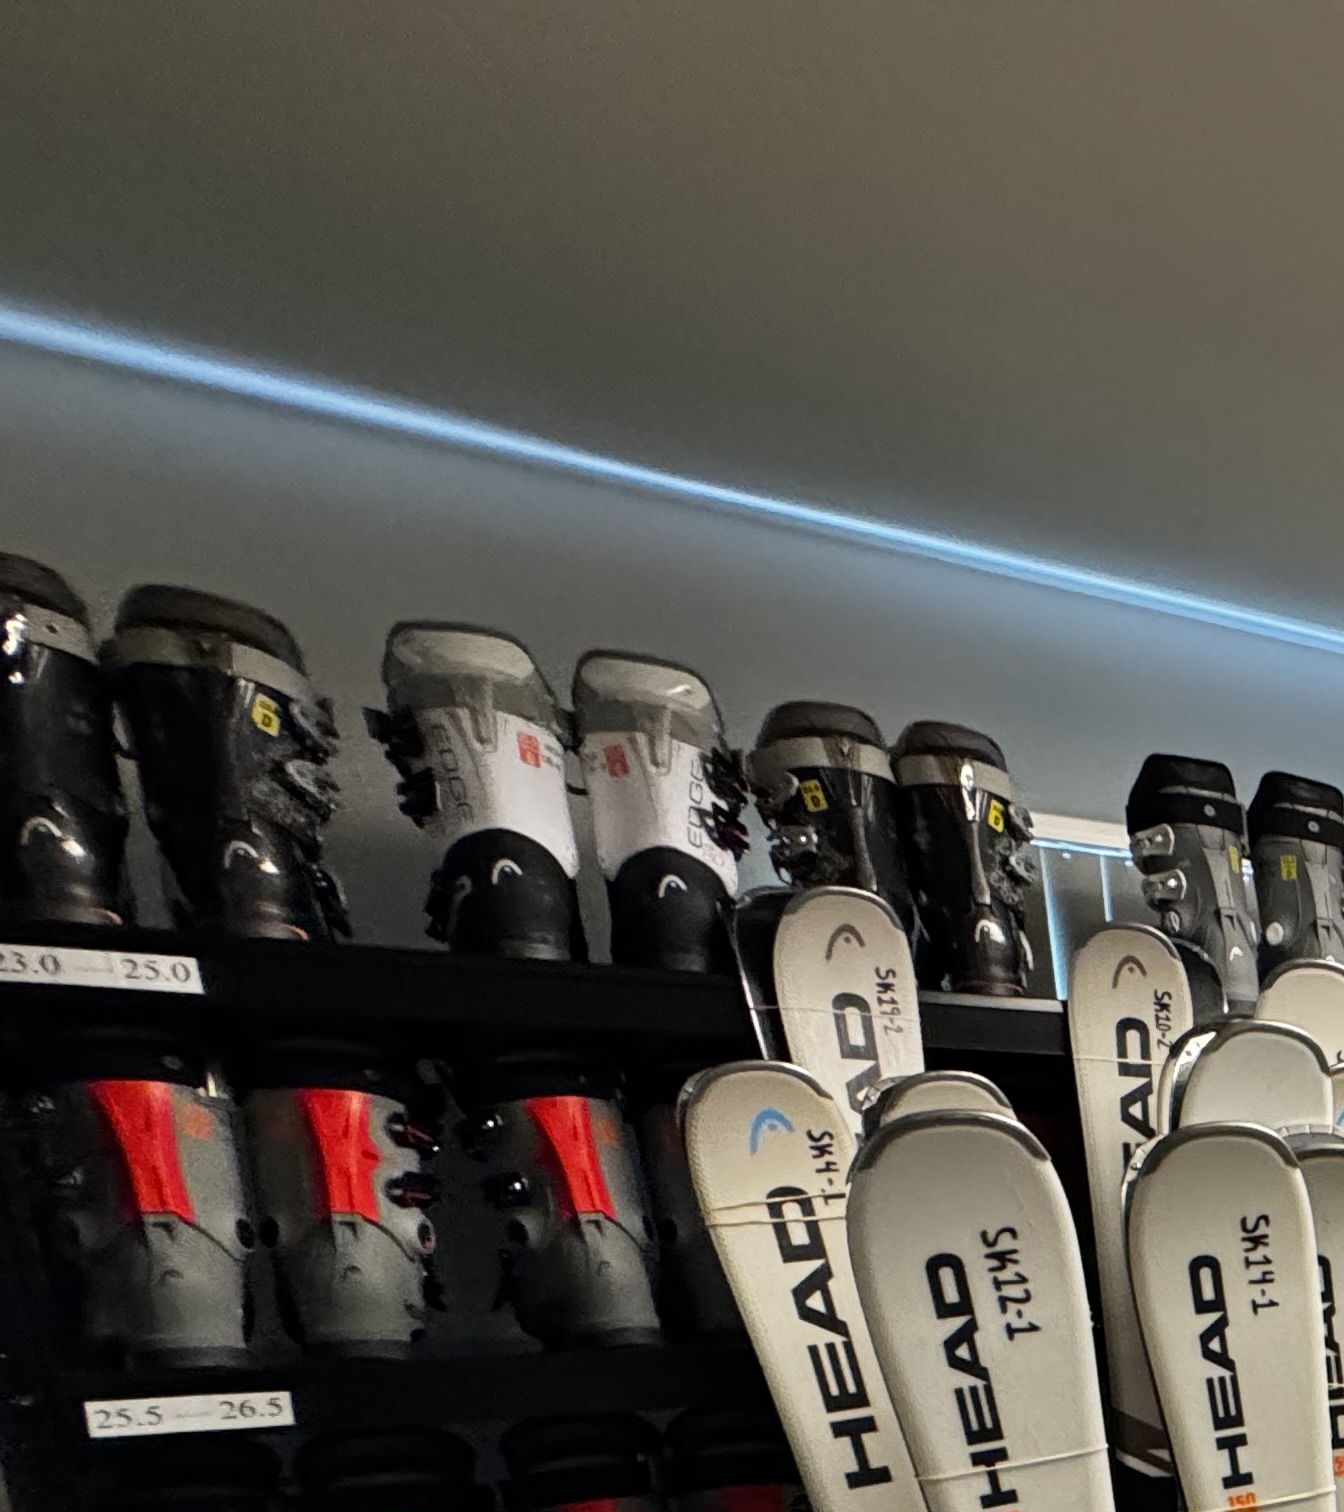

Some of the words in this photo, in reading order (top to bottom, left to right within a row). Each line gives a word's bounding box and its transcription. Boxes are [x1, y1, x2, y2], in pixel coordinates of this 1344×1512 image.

[0, 950, 61, 976] 3.0
[121, 957, 192, 983] 25.0
[831, 991, 882, 1116] AD
[1115, 1016, 1157, 1166] AD
[979, 1226, 1042, 1342] SK12-1
[1239, 1213, 1280, 1316] SK14-1
[765, 1185, 893, 1490] HEAD
[925, 1252, 1019, 1510] HEAD
[1188, 1254, 1254, 1490] HEAD
[93, 1405, 164, 1430] 25.5
[219, 1396, 285, 1421] 26.5
